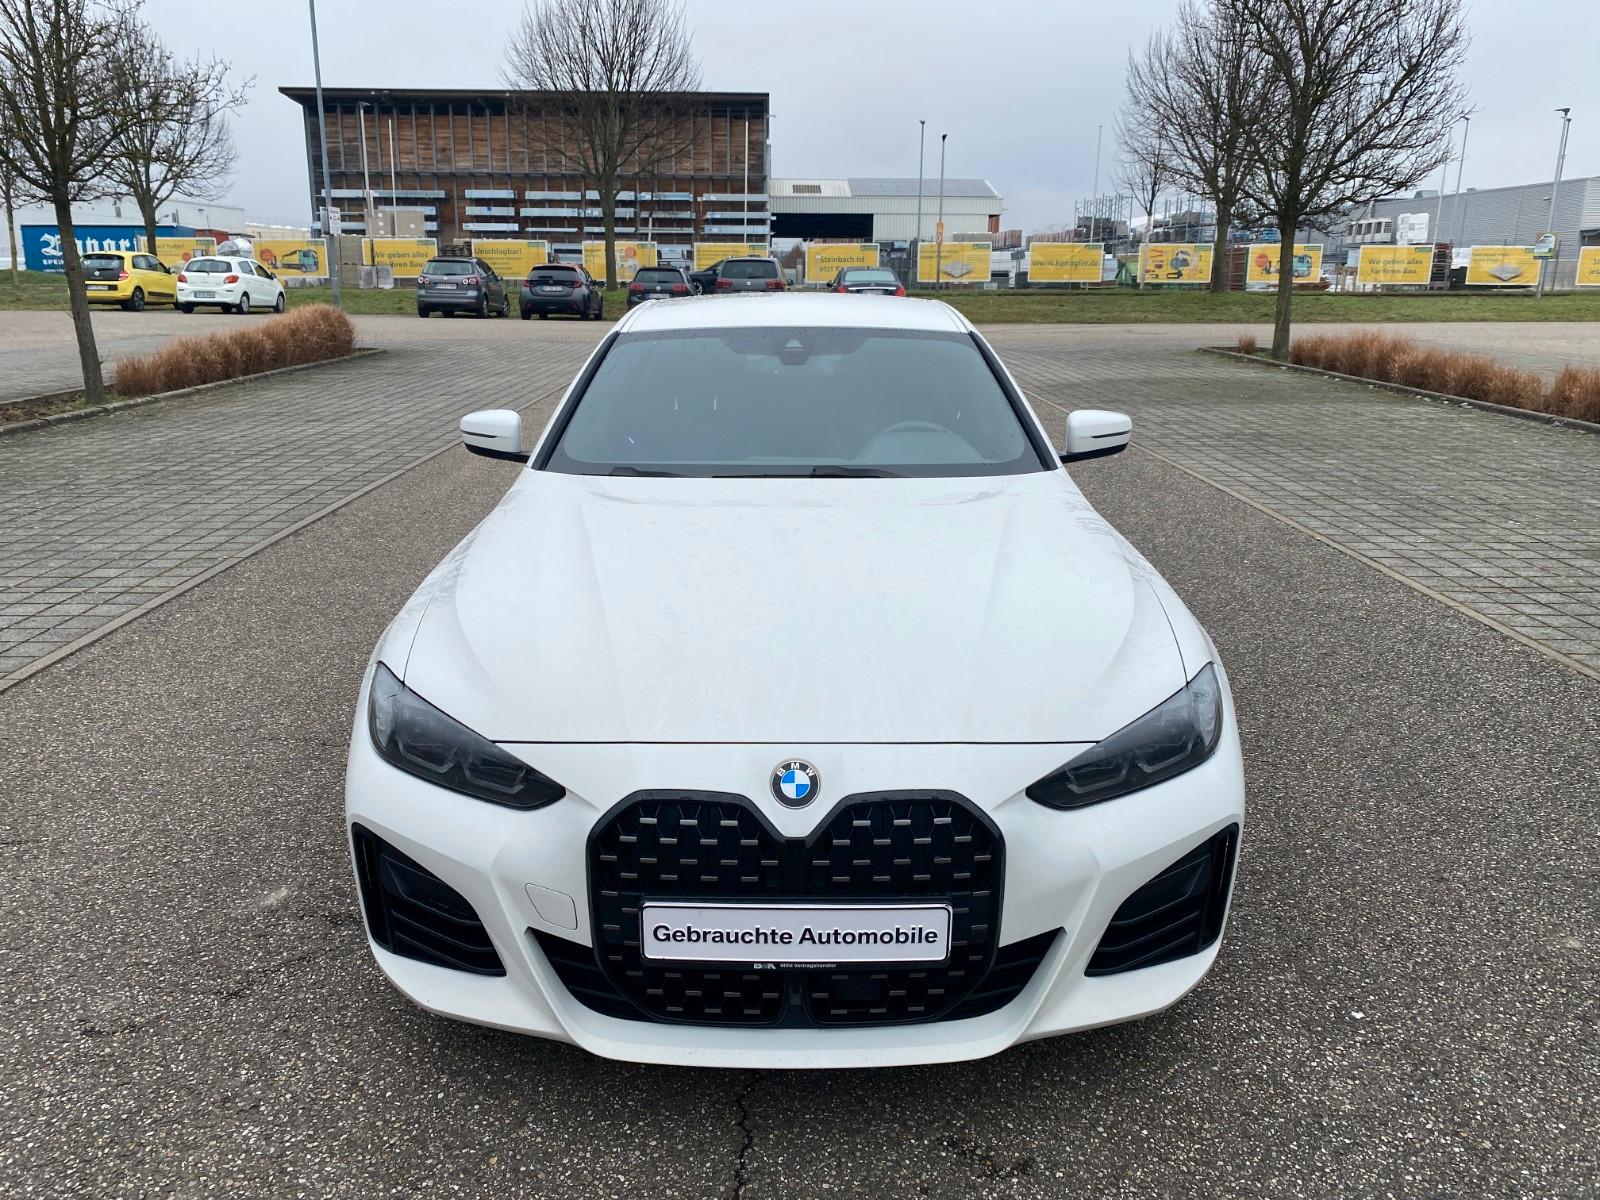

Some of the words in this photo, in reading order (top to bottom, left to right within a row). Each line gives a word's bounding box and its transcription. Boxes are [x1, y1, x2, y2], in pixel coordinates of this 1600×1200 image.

[387, 251, 410, 259] geben
[474, 248, 522, 256] Unschlagbar!
[1383, 258, 1405, 266] geben
[776, 762, 816, 777] BMW
[652, 924, 793, 945] Gebrauchte
[798, 926, 939, 945] Automobile
